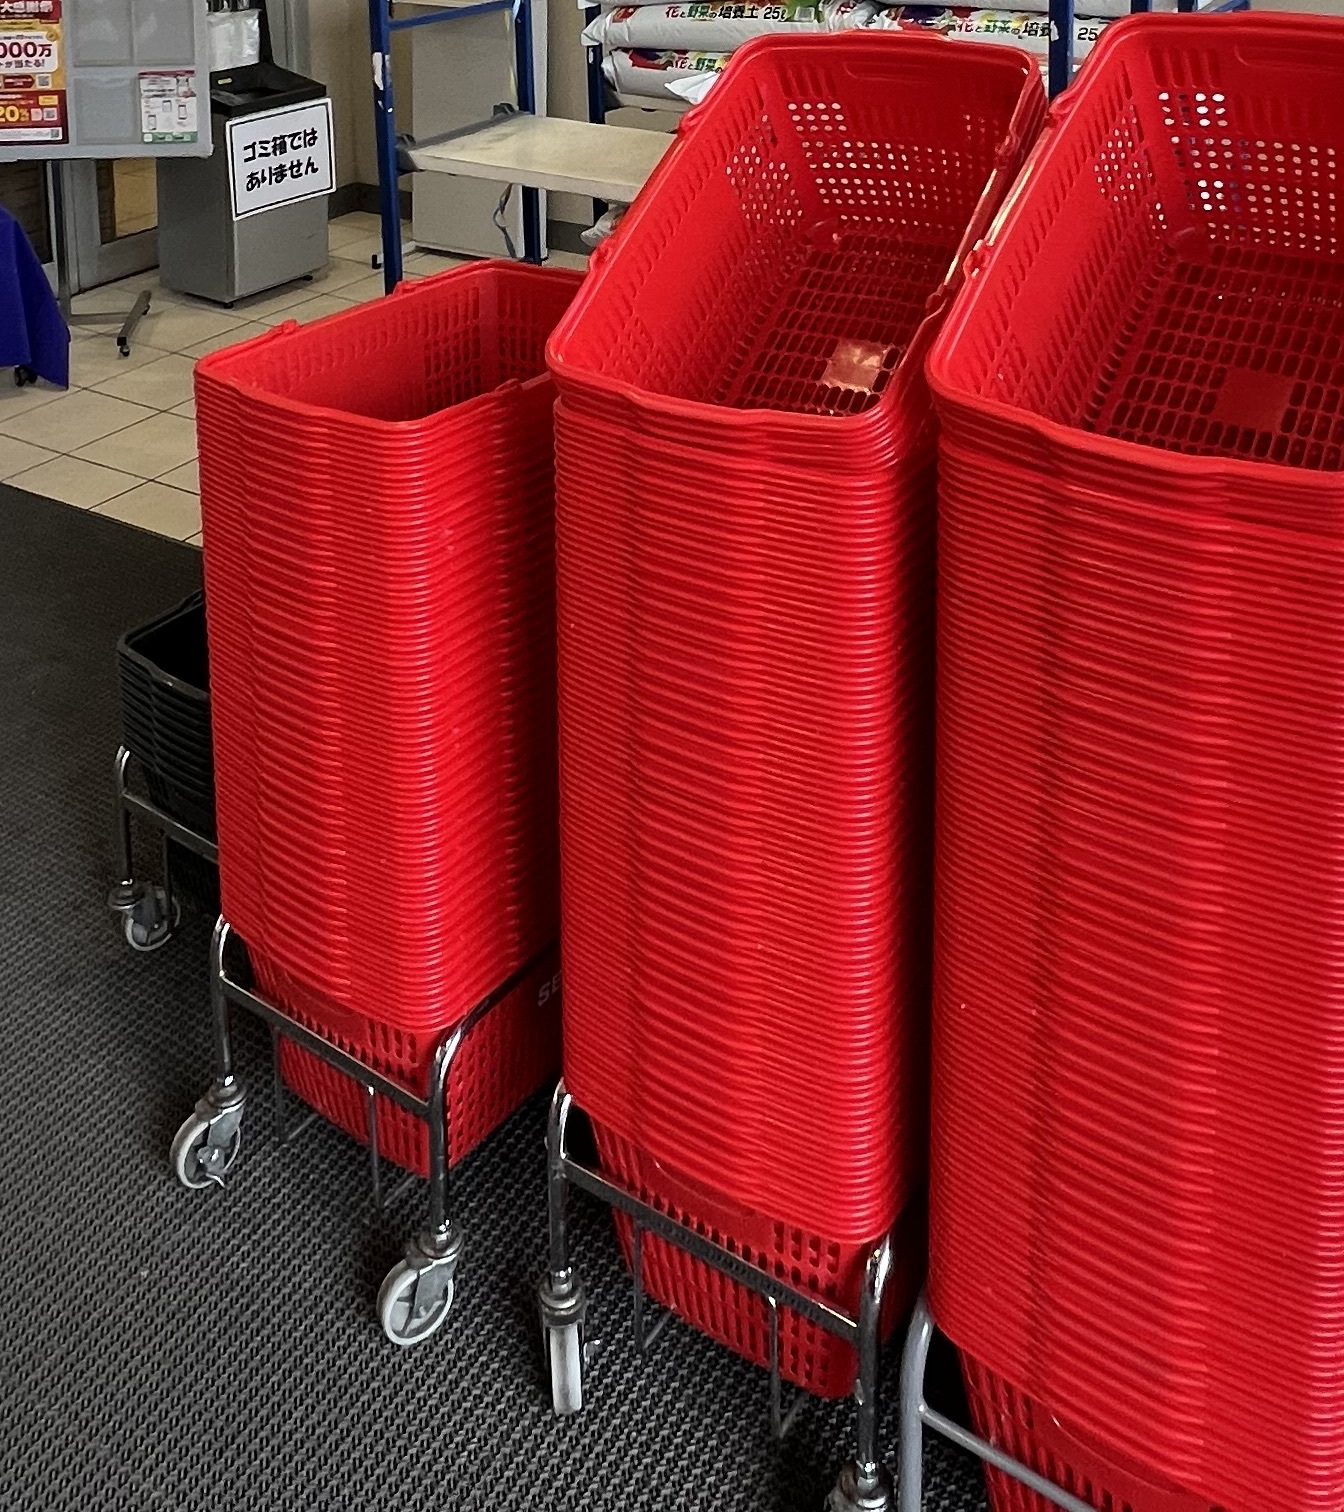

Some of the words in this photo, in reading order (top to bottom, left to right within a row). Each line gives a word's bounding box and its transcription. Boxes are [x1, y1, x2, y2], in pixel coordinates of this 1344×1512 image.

[665, 4, 759, 20] 花と野菜の培養土
[243, 126, 318, 163] ゴミ箱では
[245, 155, 319, 192] ありません
